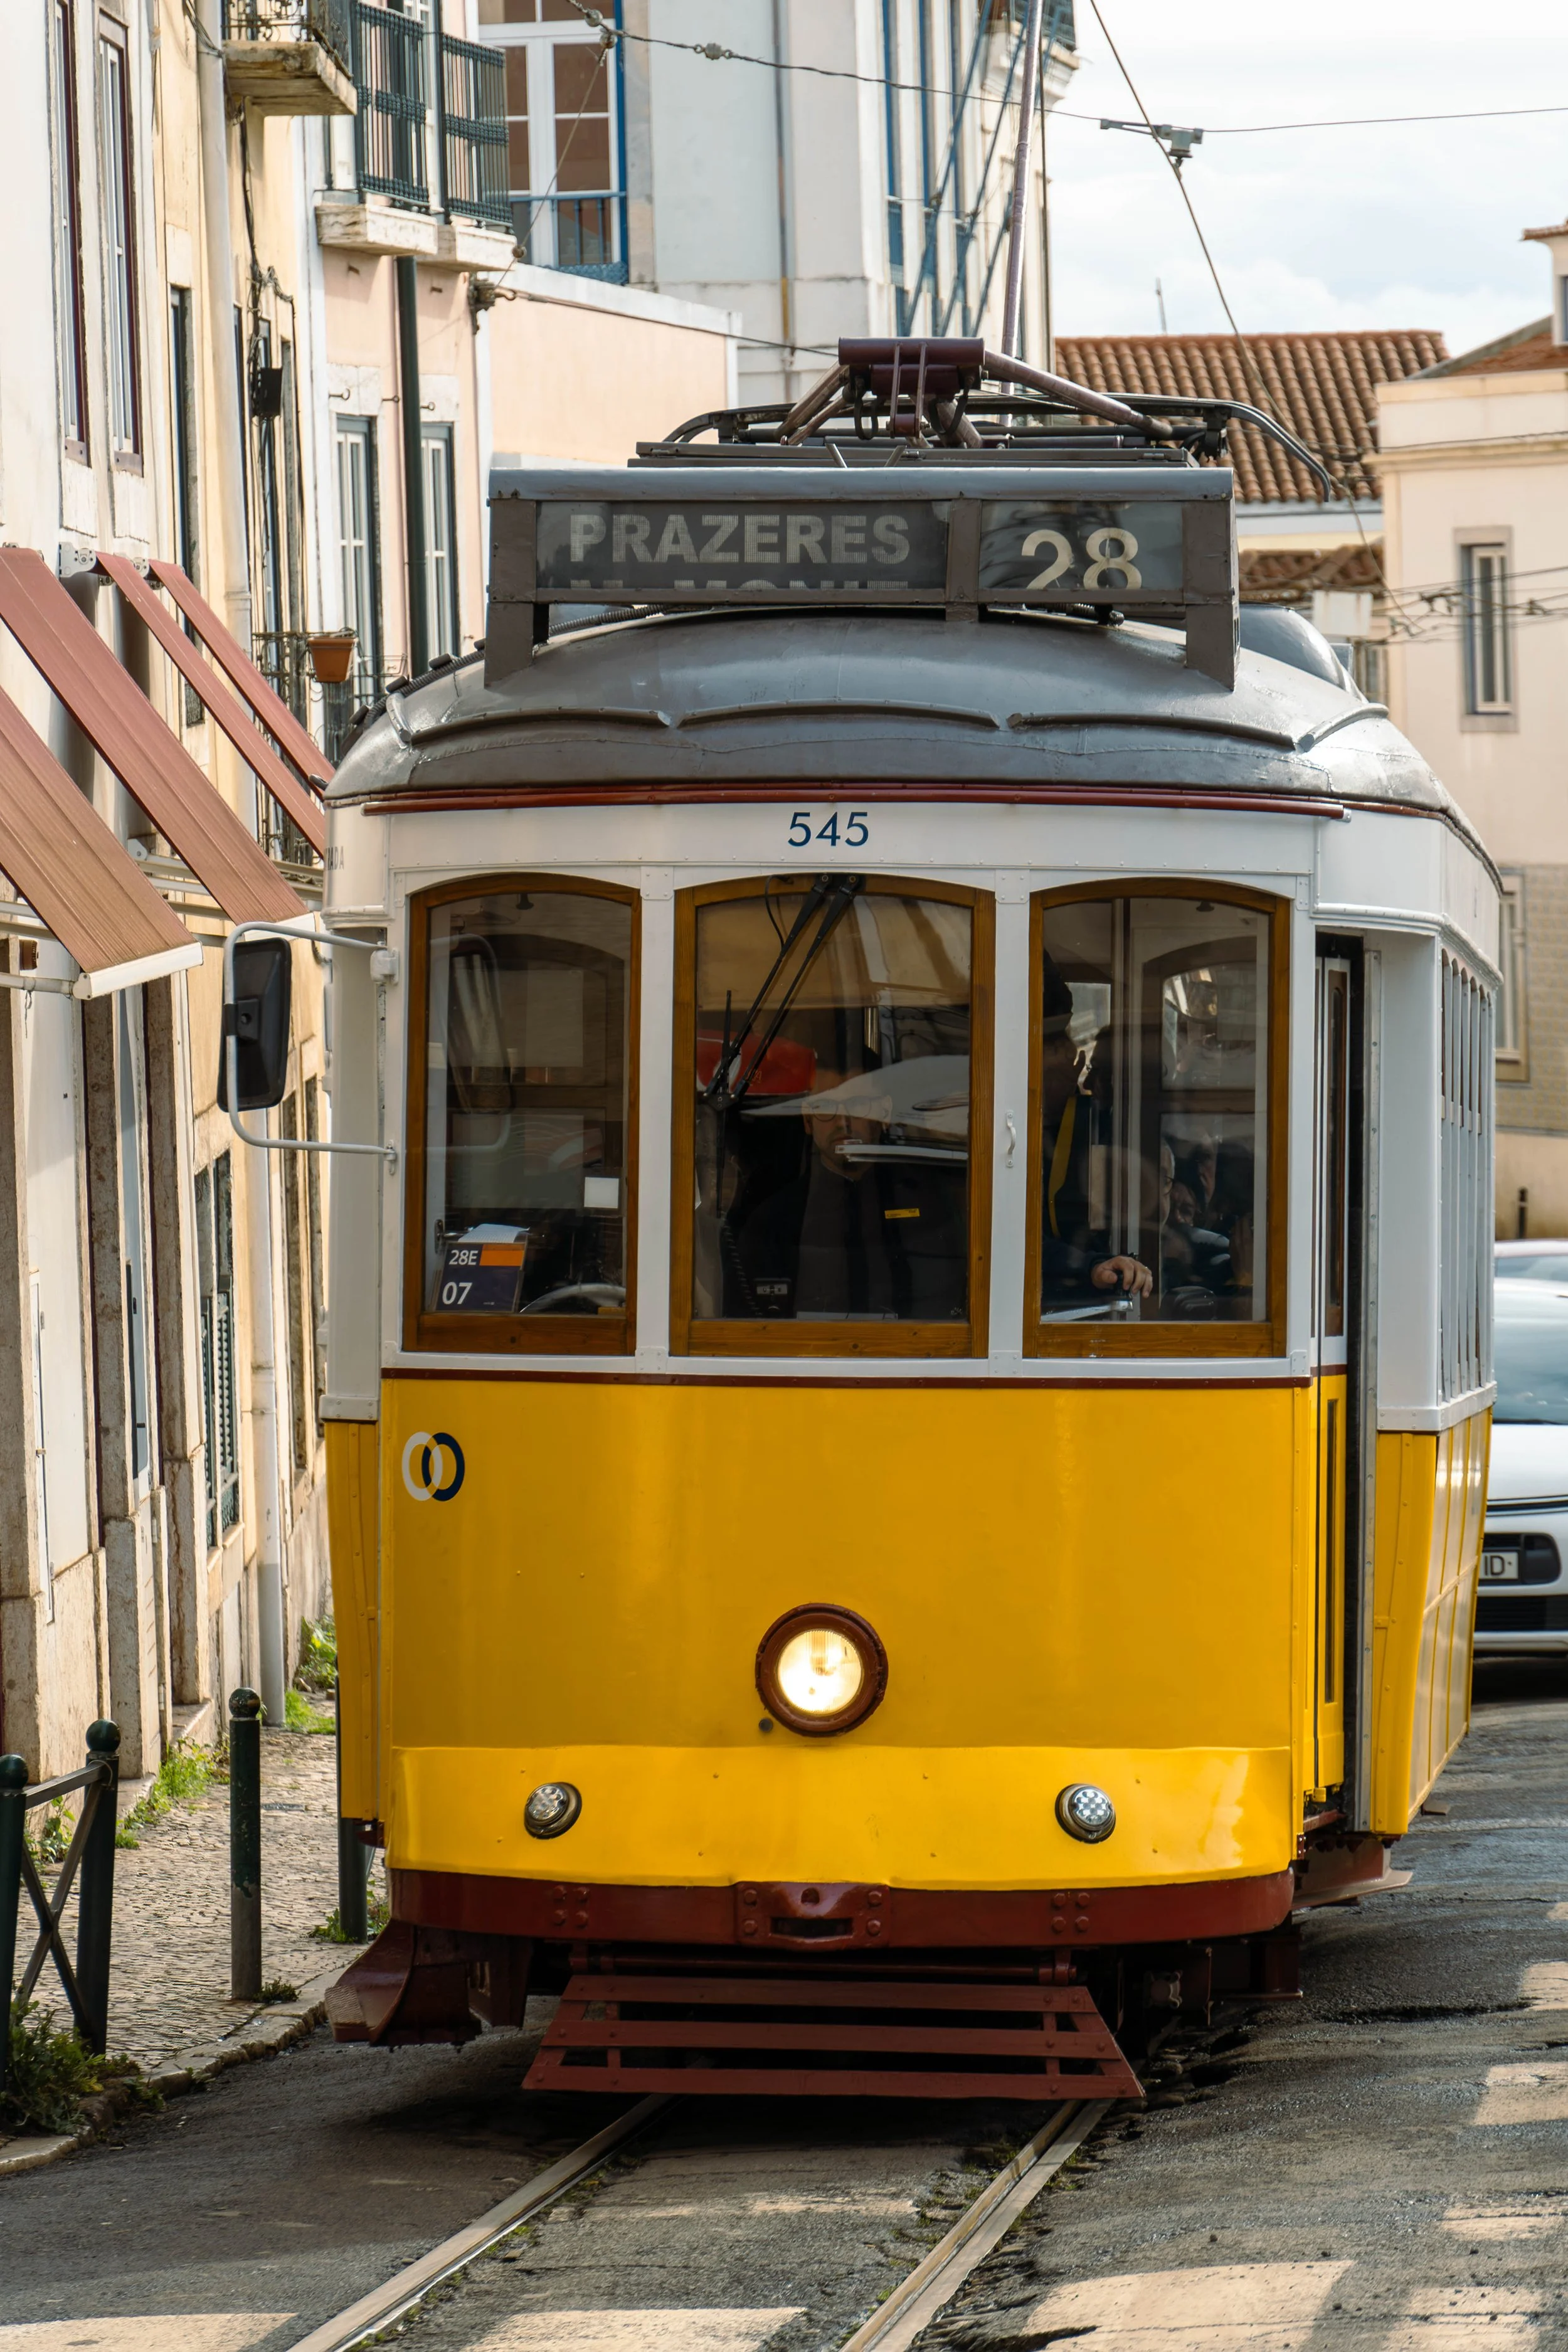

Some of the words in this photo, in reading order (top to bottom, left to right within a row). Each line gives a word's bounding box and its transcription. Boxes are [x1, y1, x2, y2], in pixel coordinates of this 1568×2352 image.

[570, 514, 910, 563] PRAZERES
[1022, 527, 1142, 590] 28
[788, 812, 869, 847] 545
[449, 1250, 479, 1265] 28E
[442, 1281, 472, 1305] 07
[1484, 1555, 1505, 1576] ID
